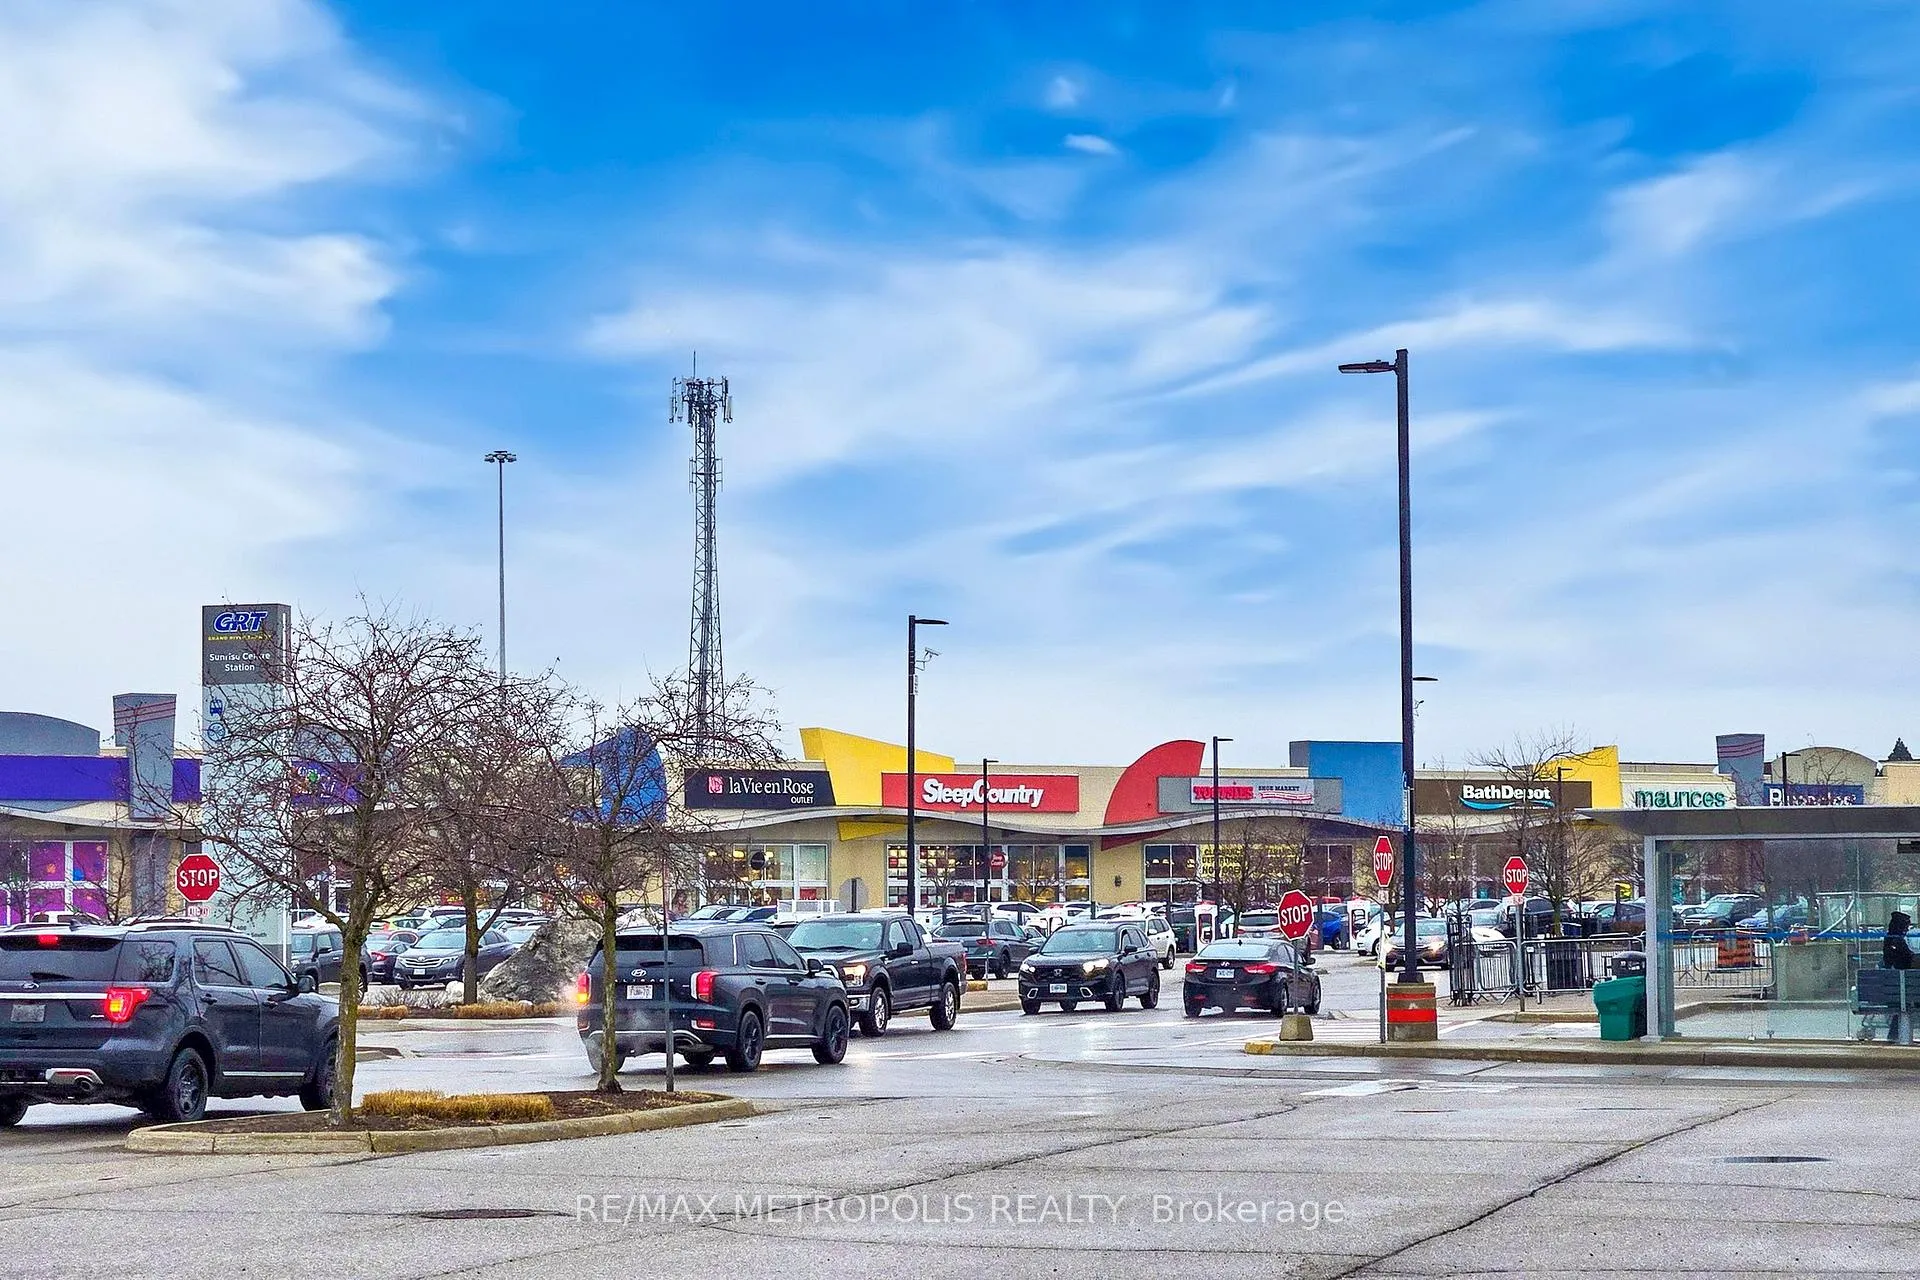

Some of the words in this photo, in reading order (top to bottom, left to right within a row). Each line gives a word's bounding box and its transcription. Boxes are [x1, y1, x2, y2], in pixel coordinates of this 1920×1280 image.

[214, 611, 268, 632] GRT
[790, 796, 814, 804] OUTLET
[1375, 852, 1393, 871] STOP
[180, 869, 218, 887] STOP
[1506, 868, 1527, 883] STOP
[1281, 904, 1310, 927] STOP
